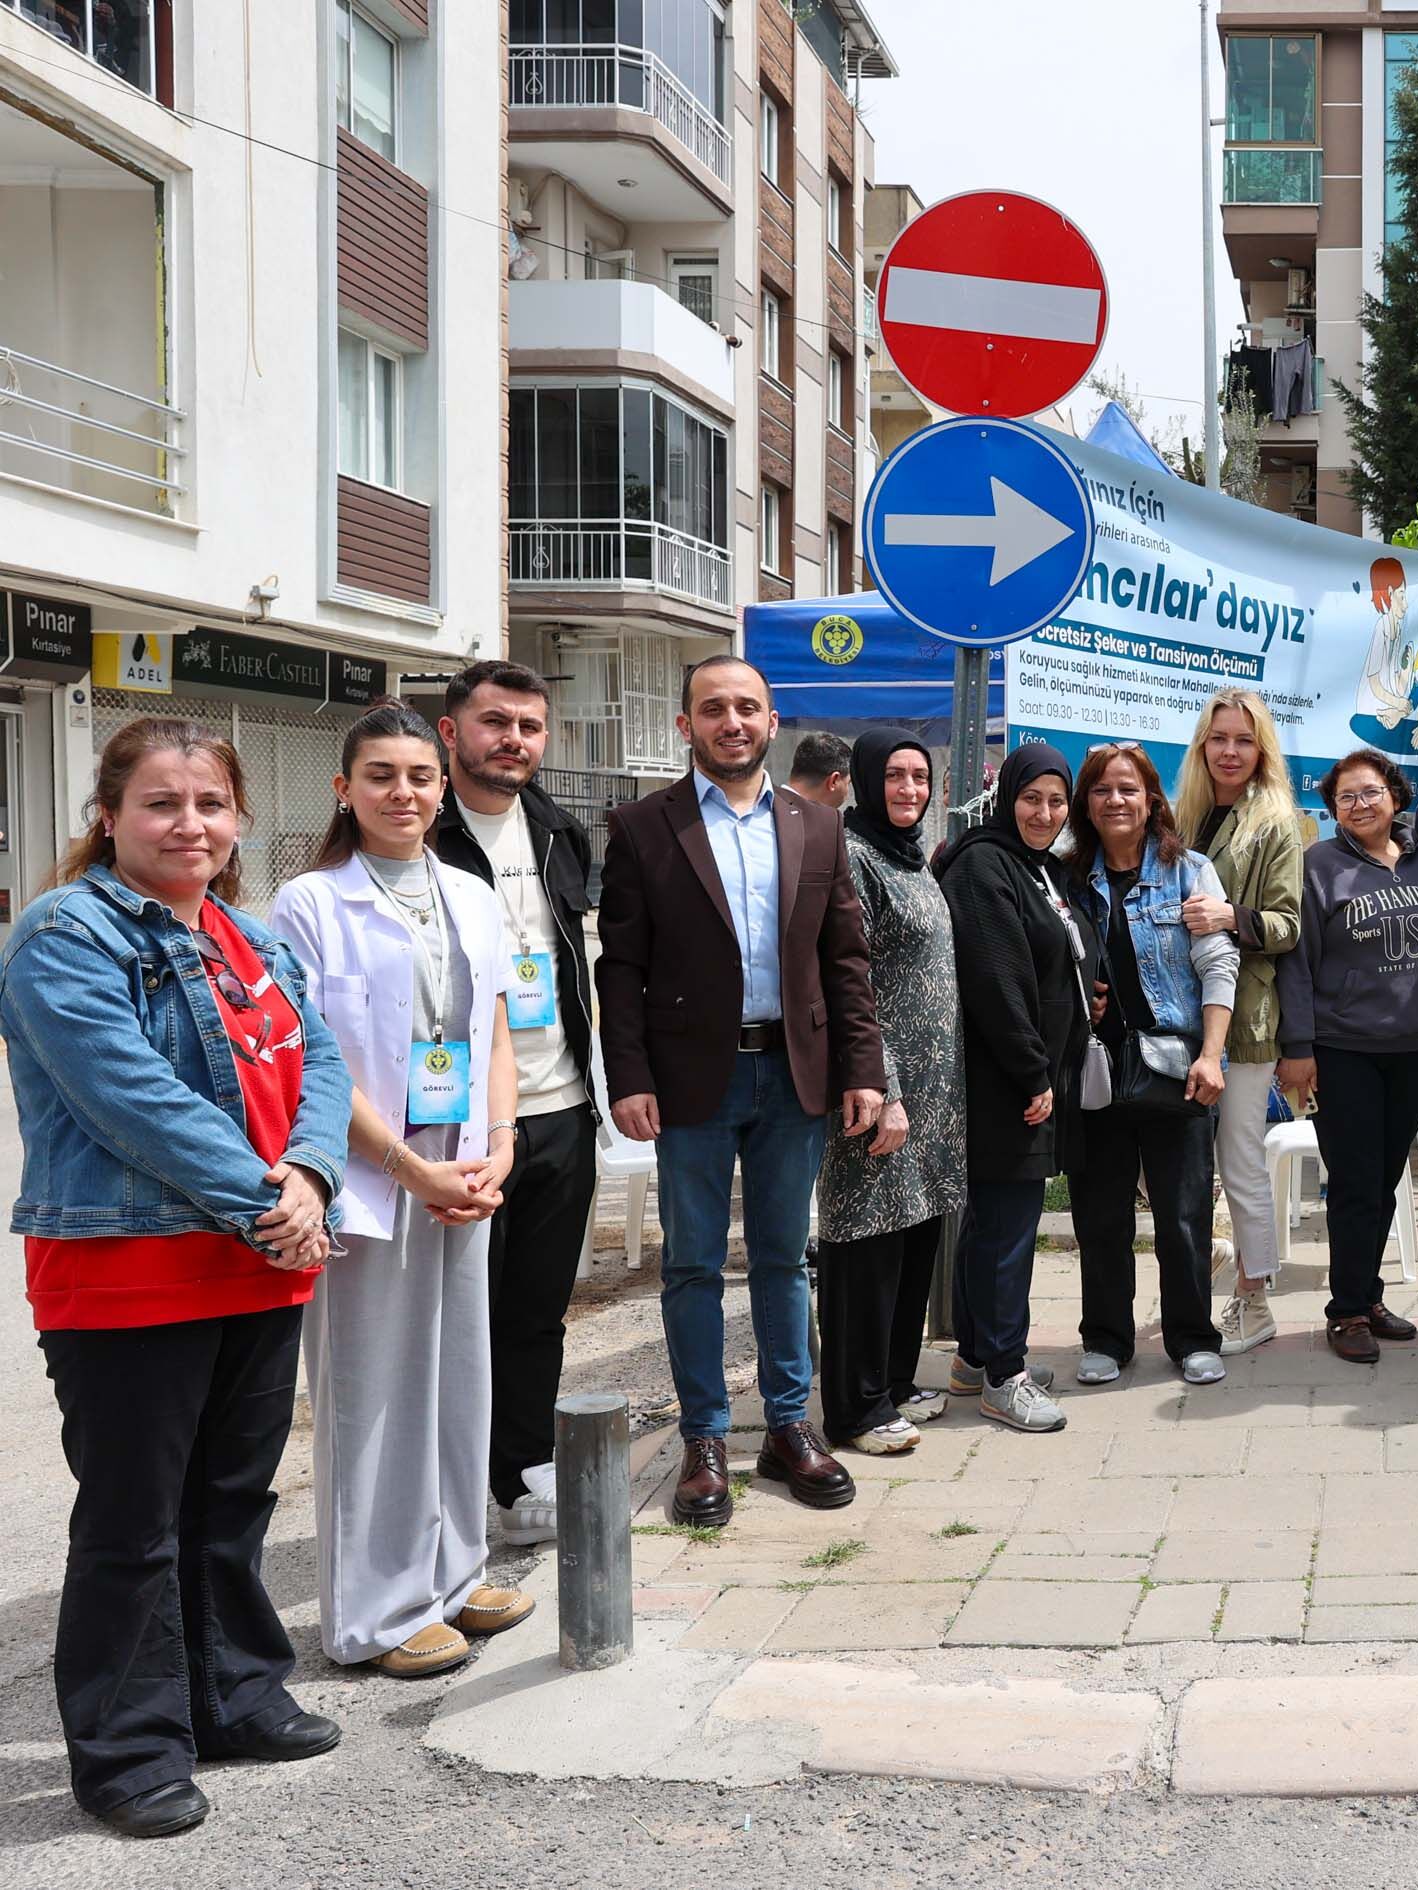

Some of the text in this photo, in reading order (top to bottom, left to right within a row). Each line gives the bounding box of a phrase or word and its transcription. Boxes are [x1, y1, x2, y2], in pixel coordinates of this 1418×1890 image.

[1077, 467, 1127, 511] ınız
[1130, 532, 1171, 555] arasında
[26, 601, 76, 634] Pınar
[1076, 560, 1305, 653] ncılar'dayız
[32, 637, 72, 656] Kırtasiye
[1094, 630, 1129, 656] Şeker
[1131, 644, 1147, 659] ve
[1149, 642, 1208, 671] Tansiyon
[1210, 649, 1259, 678] Ölçümü
[127, 667, 163, 683] ADEL
[219, 645, 321, 686] FABER-CASTELL
[343, 659, 372, 682] Pınar
[1019, 649, 1069, 672] Koruyucu
[1071, 660, 1101, 679] sağlık
[1102, 662, 1139, 682] hizmeti
[1140, 670, 1181, 690] Akıncılar
[1182, 678, 1226, 696] Mahalle
[1019, 672, 1049, 693] Gelin,
[1050, 675, 1112, 700] ölçümünüzü
[1113, 688, 1153, 706] yaparak
[1154, 695, 1166, 707] en
[1166, 696, 1193, 714] doğru
[1018, 699, 1045, 717] Saat:
[1046, 702, 1073, 720] 09.30
[1081, 707, 1103, 724] 12.30
[1110, 711, 1131, 728] 13.30
[1138, 715, 1160, 731] 16.30
[1344, 894, 1377, 929] THE
[1352, 928, 1382, 942] Sports
[1378, 964, 1402, 973] STATE
